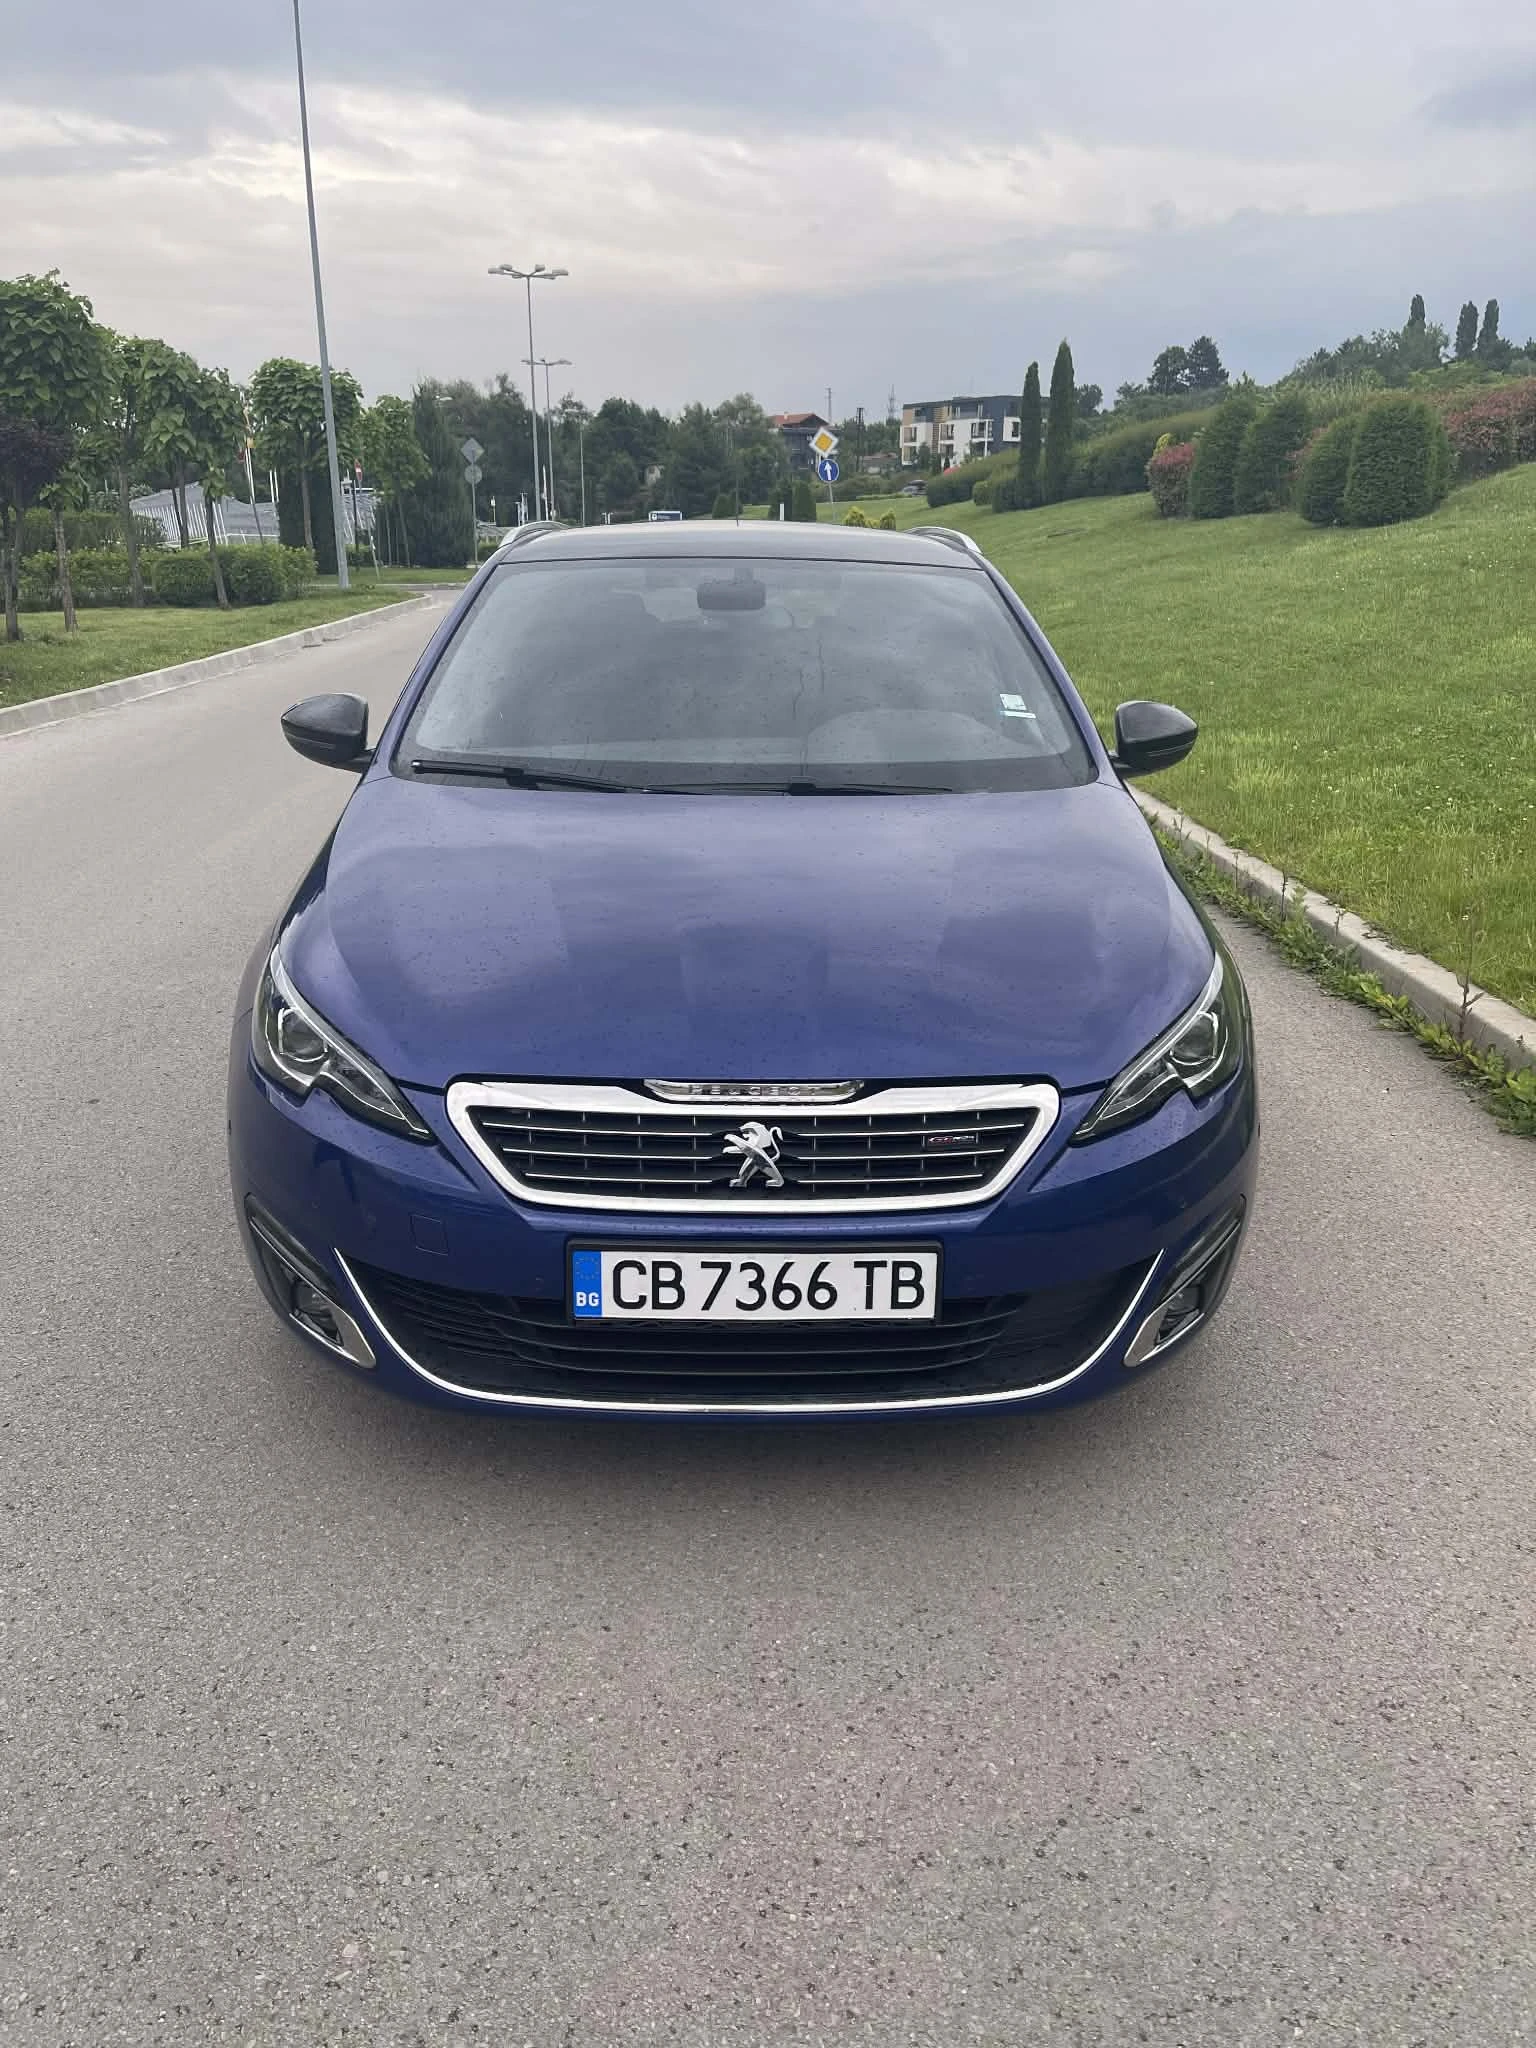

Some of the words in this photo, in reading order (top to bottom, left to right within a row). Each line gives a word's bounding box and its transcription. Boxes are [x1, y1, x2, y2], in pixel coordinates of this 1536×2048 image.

[575, 1291, 600, 1307] BG
[612, 1260, 685, 1311] CB
[700, 1260, 839, 1311] 7366
[853, 1260, 925, 1310] TB
